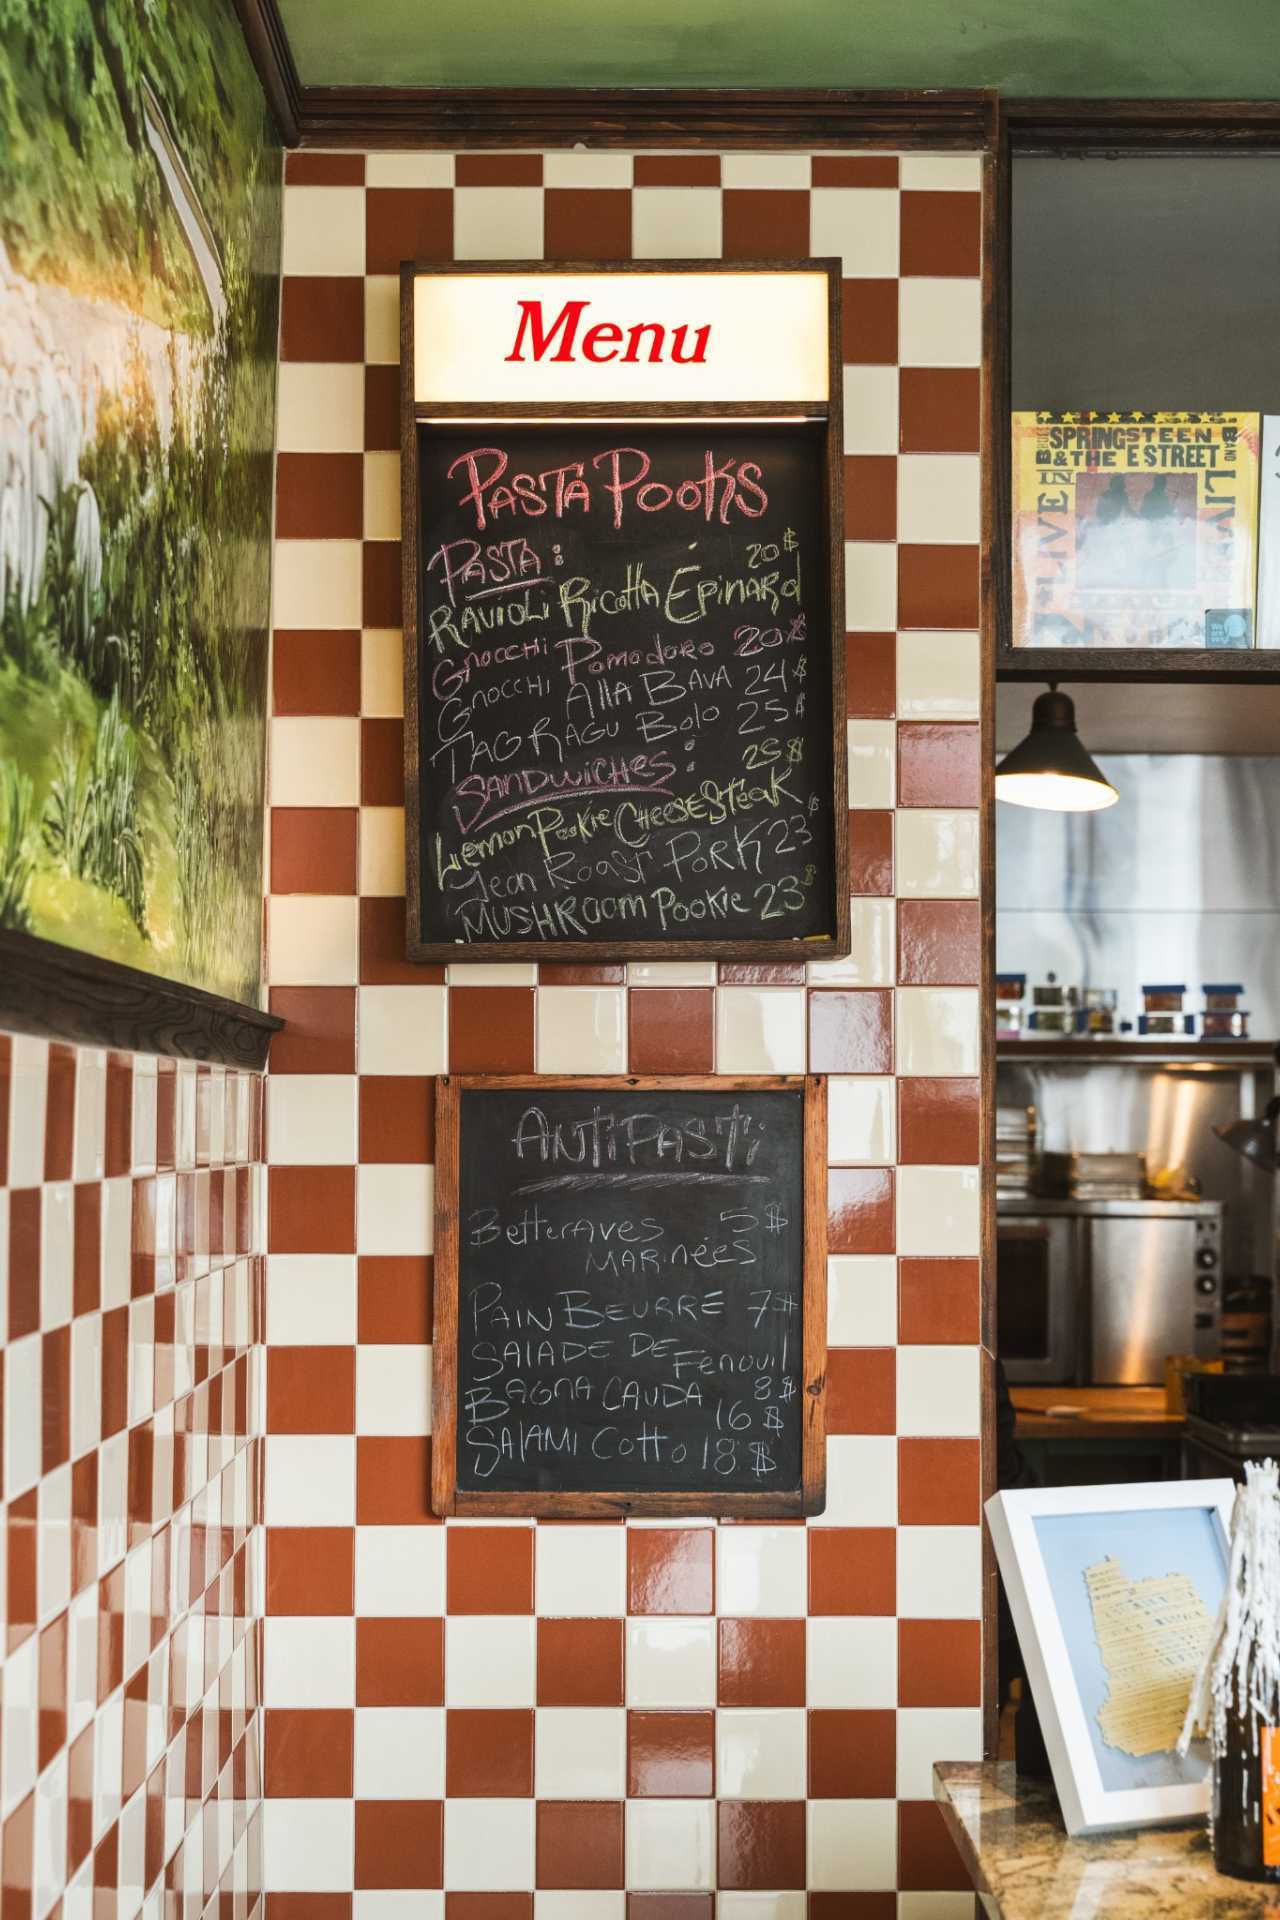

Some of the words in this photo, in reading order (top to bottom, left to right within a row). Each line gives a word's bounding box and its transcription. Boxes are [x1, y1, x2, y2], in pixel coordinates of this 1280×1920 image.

[504, 301, 711, 364] Menu
[1050, 427, 1212, 449] SPRINGSTEEN
[1053, 450, 1067, 467] &
[1070, 450, 1116, 467] THE
[1127, 444, 1139, 467] E
[1144, 444, 1220, 468] STREET
[1222, 427, 1238, 462] BAND
[447, 448, 590, 531] PASTA
[744, 654, 807, 696] 24$
[469, 1281, 552, 1335] PAIN
[602, 1376, 704, 1411] CAUDA
[716, 1400, 786, 1438] 16$
[702, 1436, 778, 1477] 18$
